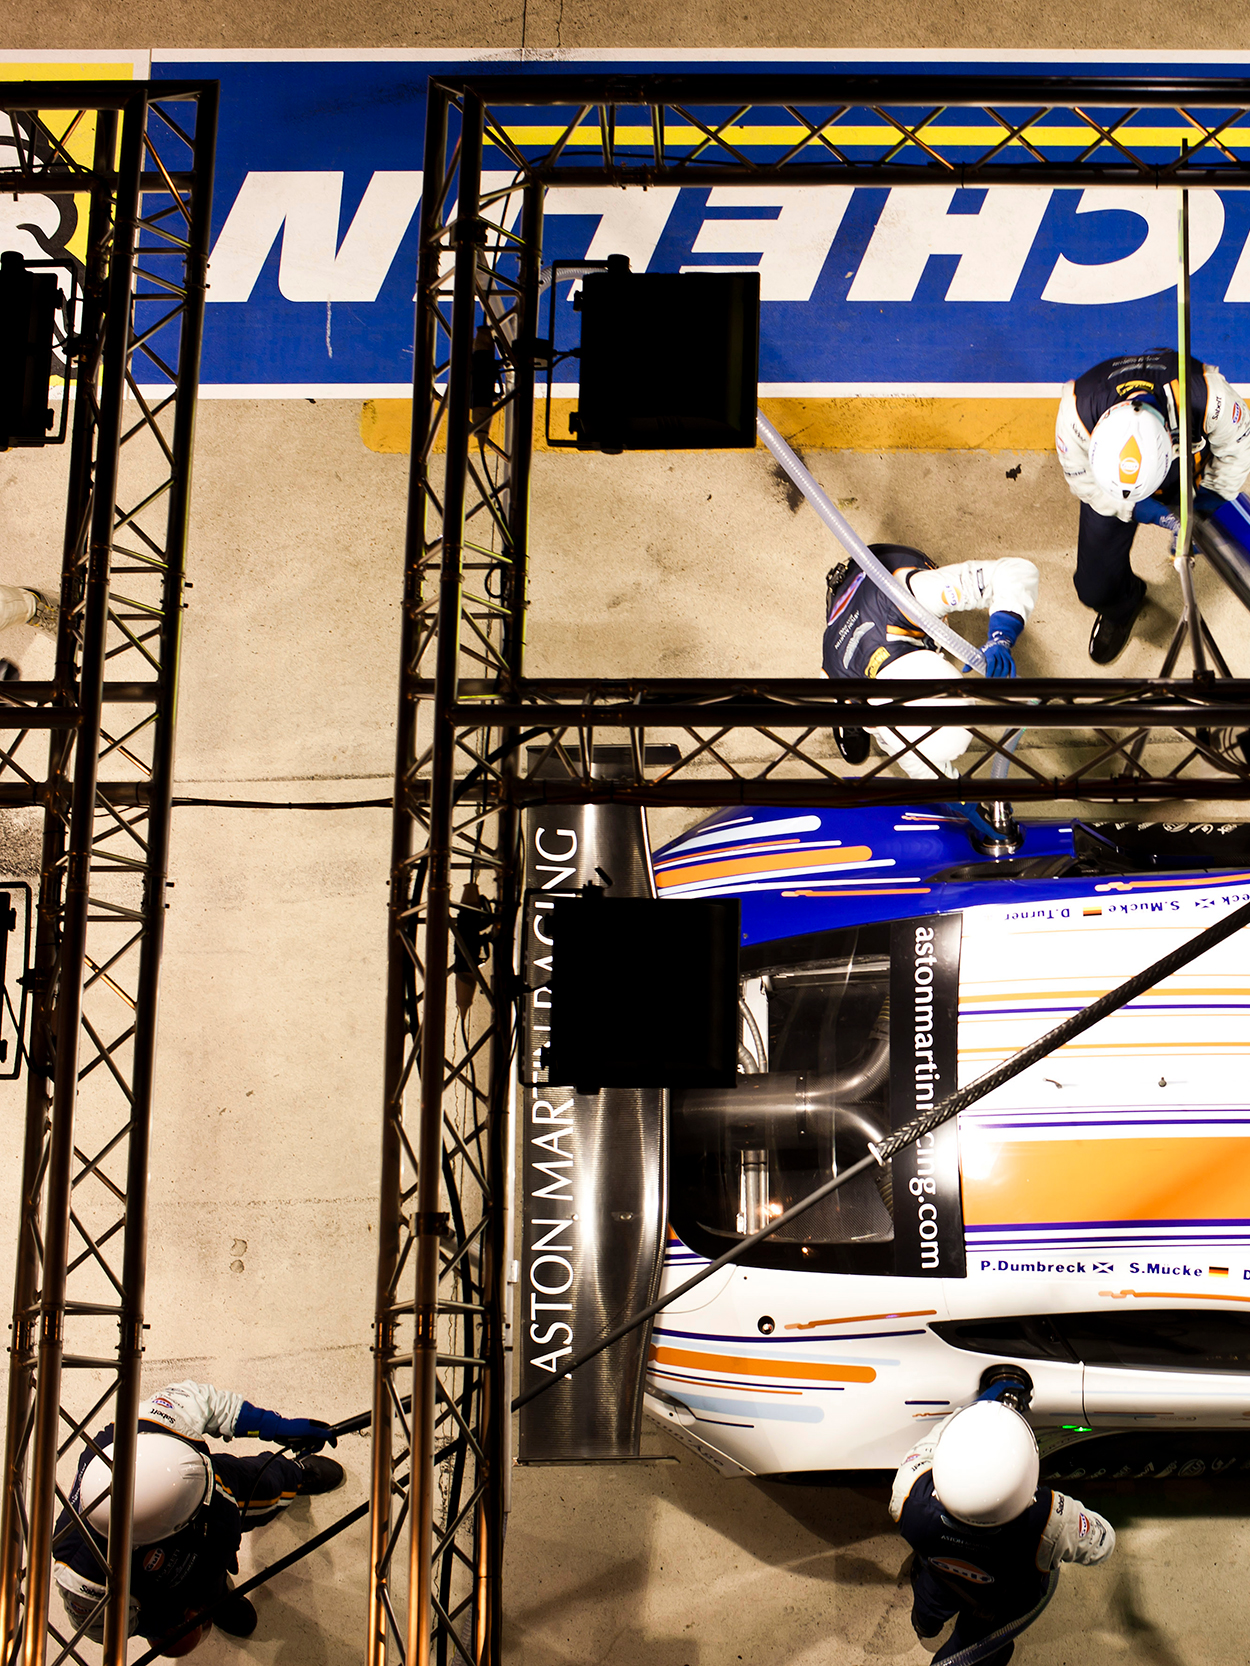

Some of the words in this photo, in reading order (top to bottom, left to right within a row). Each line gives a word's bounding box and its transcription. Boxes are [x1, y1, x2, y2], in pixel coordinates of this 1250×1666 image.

[908, 926, 941, 1270] astonmartinrcing.com
[529, 1218, 574, 1380] ASTON
[980, 1260, 1087, 1274] P.Dumbreck
[1129, 1262, 1203, 1278] S.Mücke
[146, 1549, 164, 1571] Gulf
